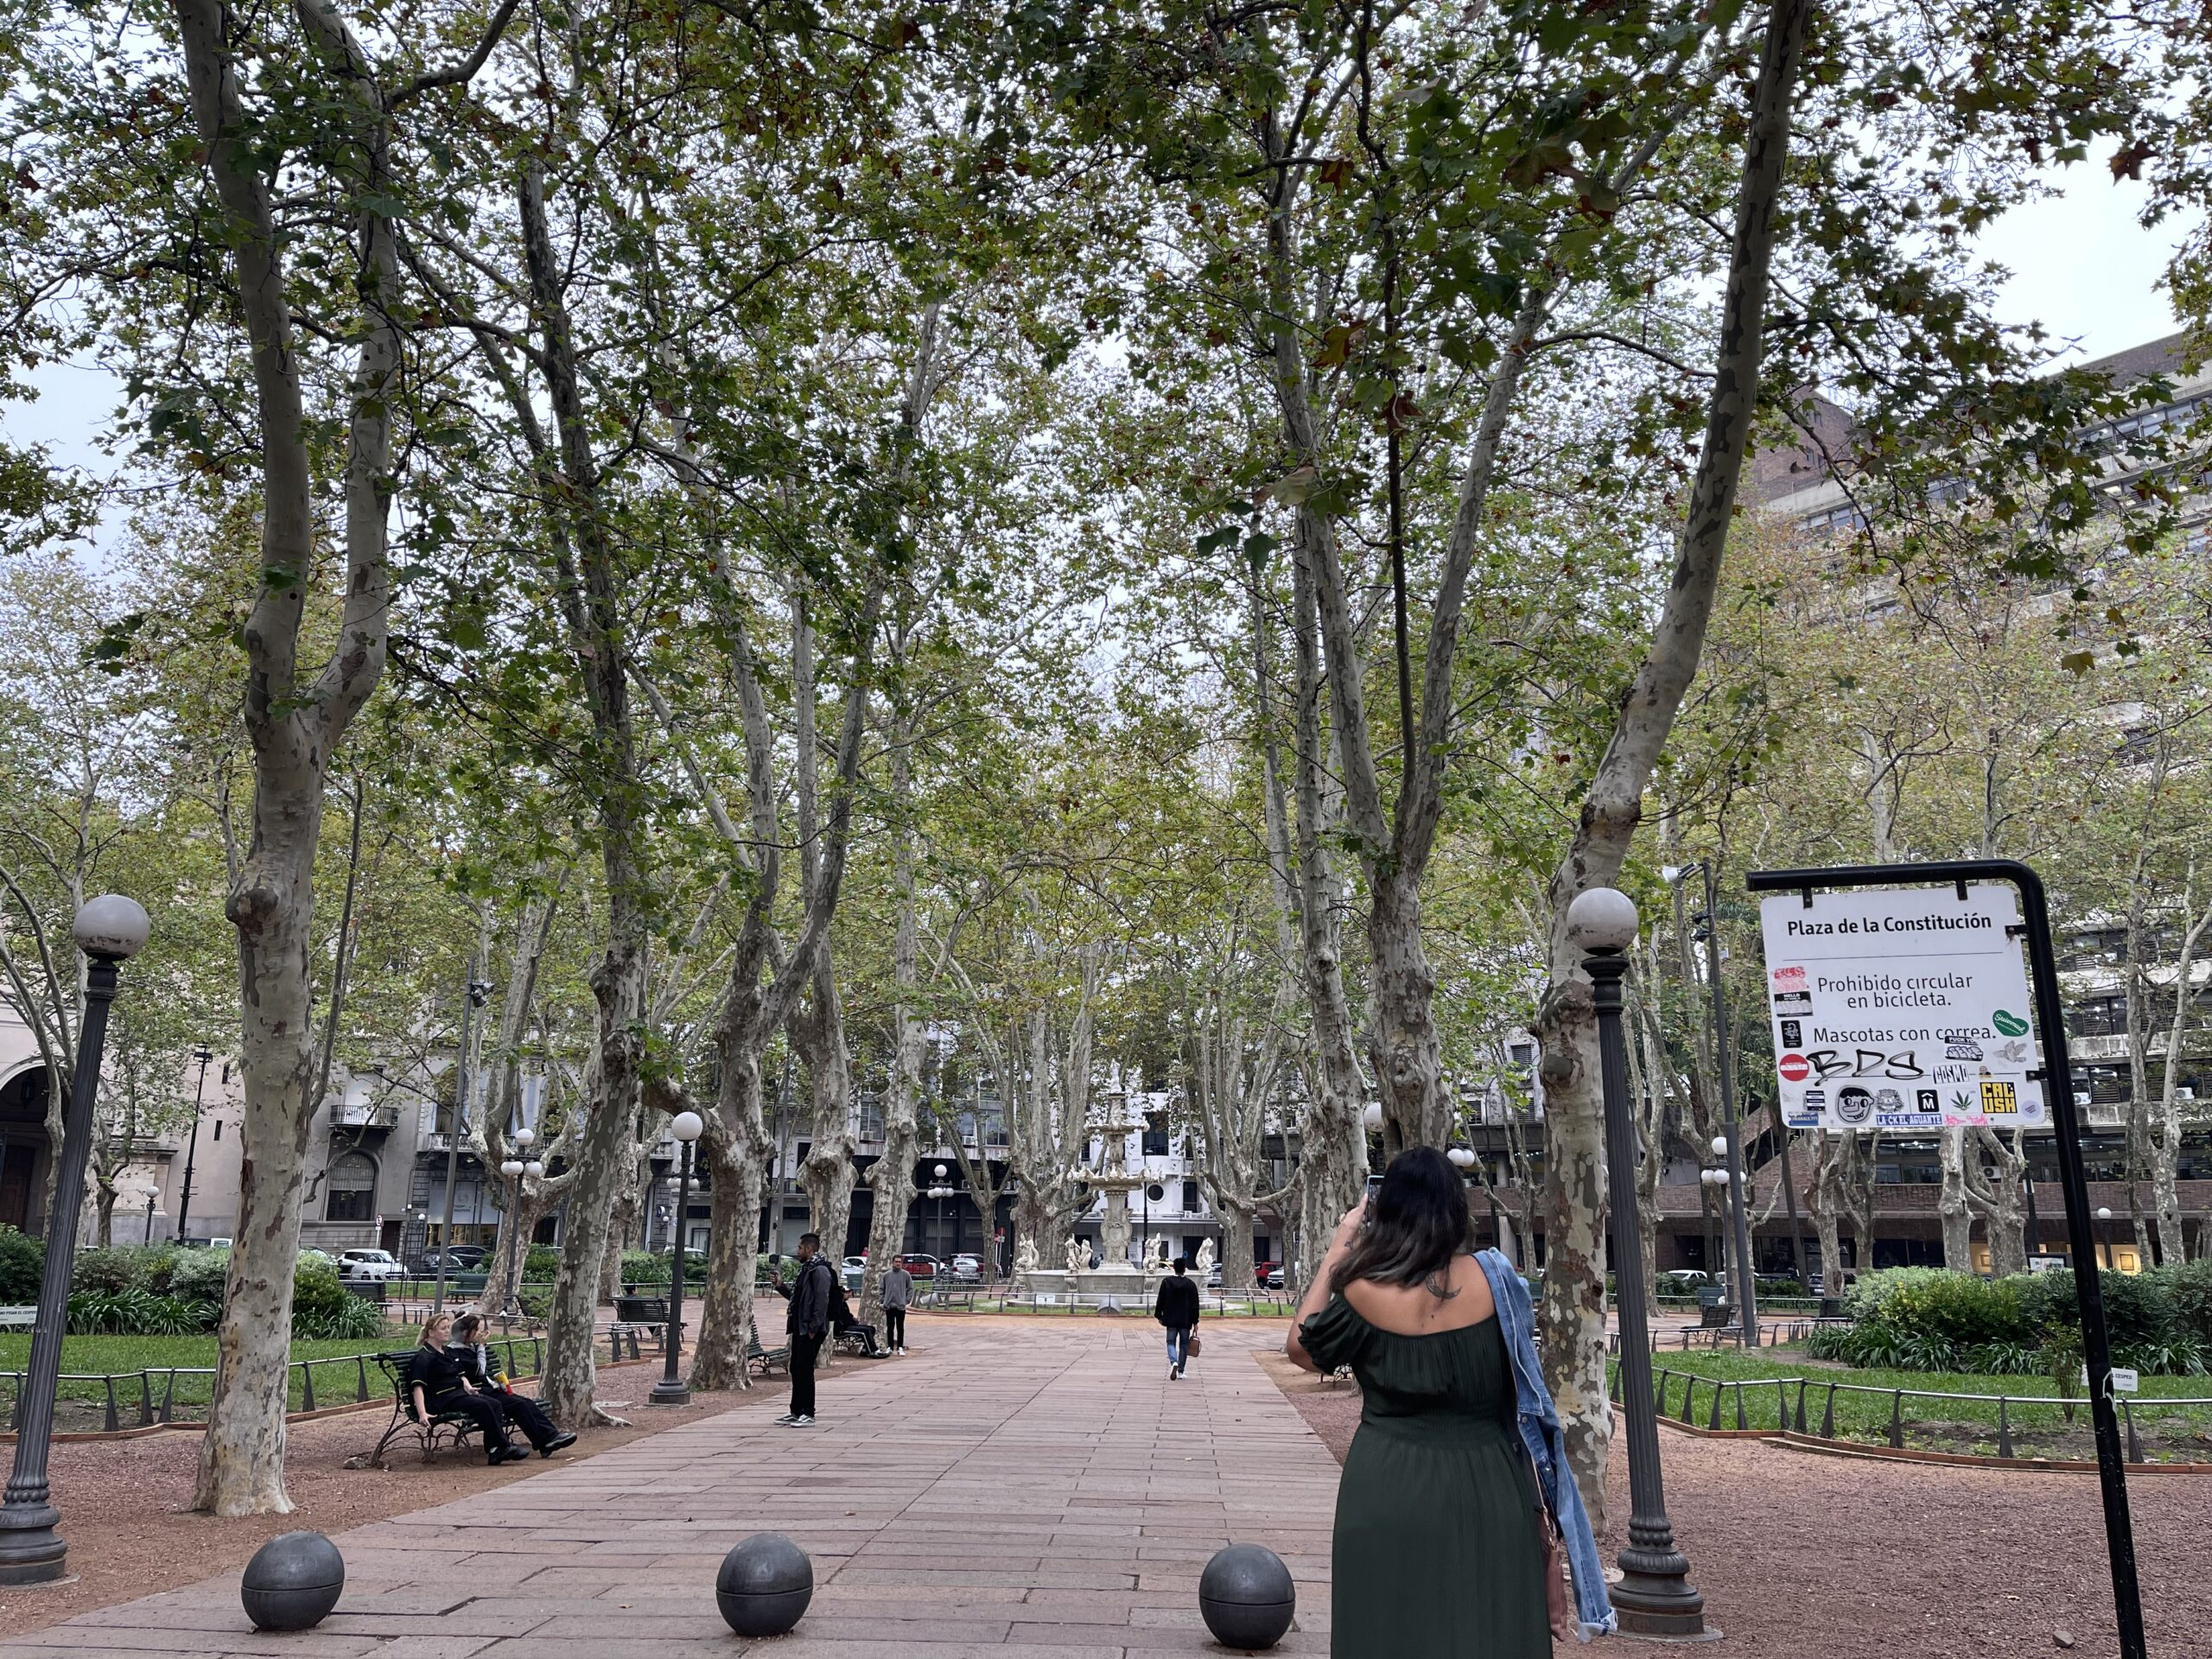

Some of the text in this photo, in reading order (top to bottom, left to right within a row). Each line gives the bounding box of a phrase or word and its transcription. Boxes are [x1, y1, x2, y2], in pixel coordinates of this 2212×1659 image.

[1787, 912, 1992, 936] Plaza de la Constitución
[1818, 974, 1901, 993] Prohibido
[1906, 972, 1974, 990] circular
[1847, 990, 1952, 1008] en bicicleta.
[1814, 1027, 1894, 1044] Mascotas
[1900, 1030, 1930, 1041] con
[1936, 1027, 1997, 1039] correa.
[1933, 1064, 1969, 1084] COSMO
[1980, 1083, 2015, 1097] CAL
[1982, 1097, 2017, 1113] USH
